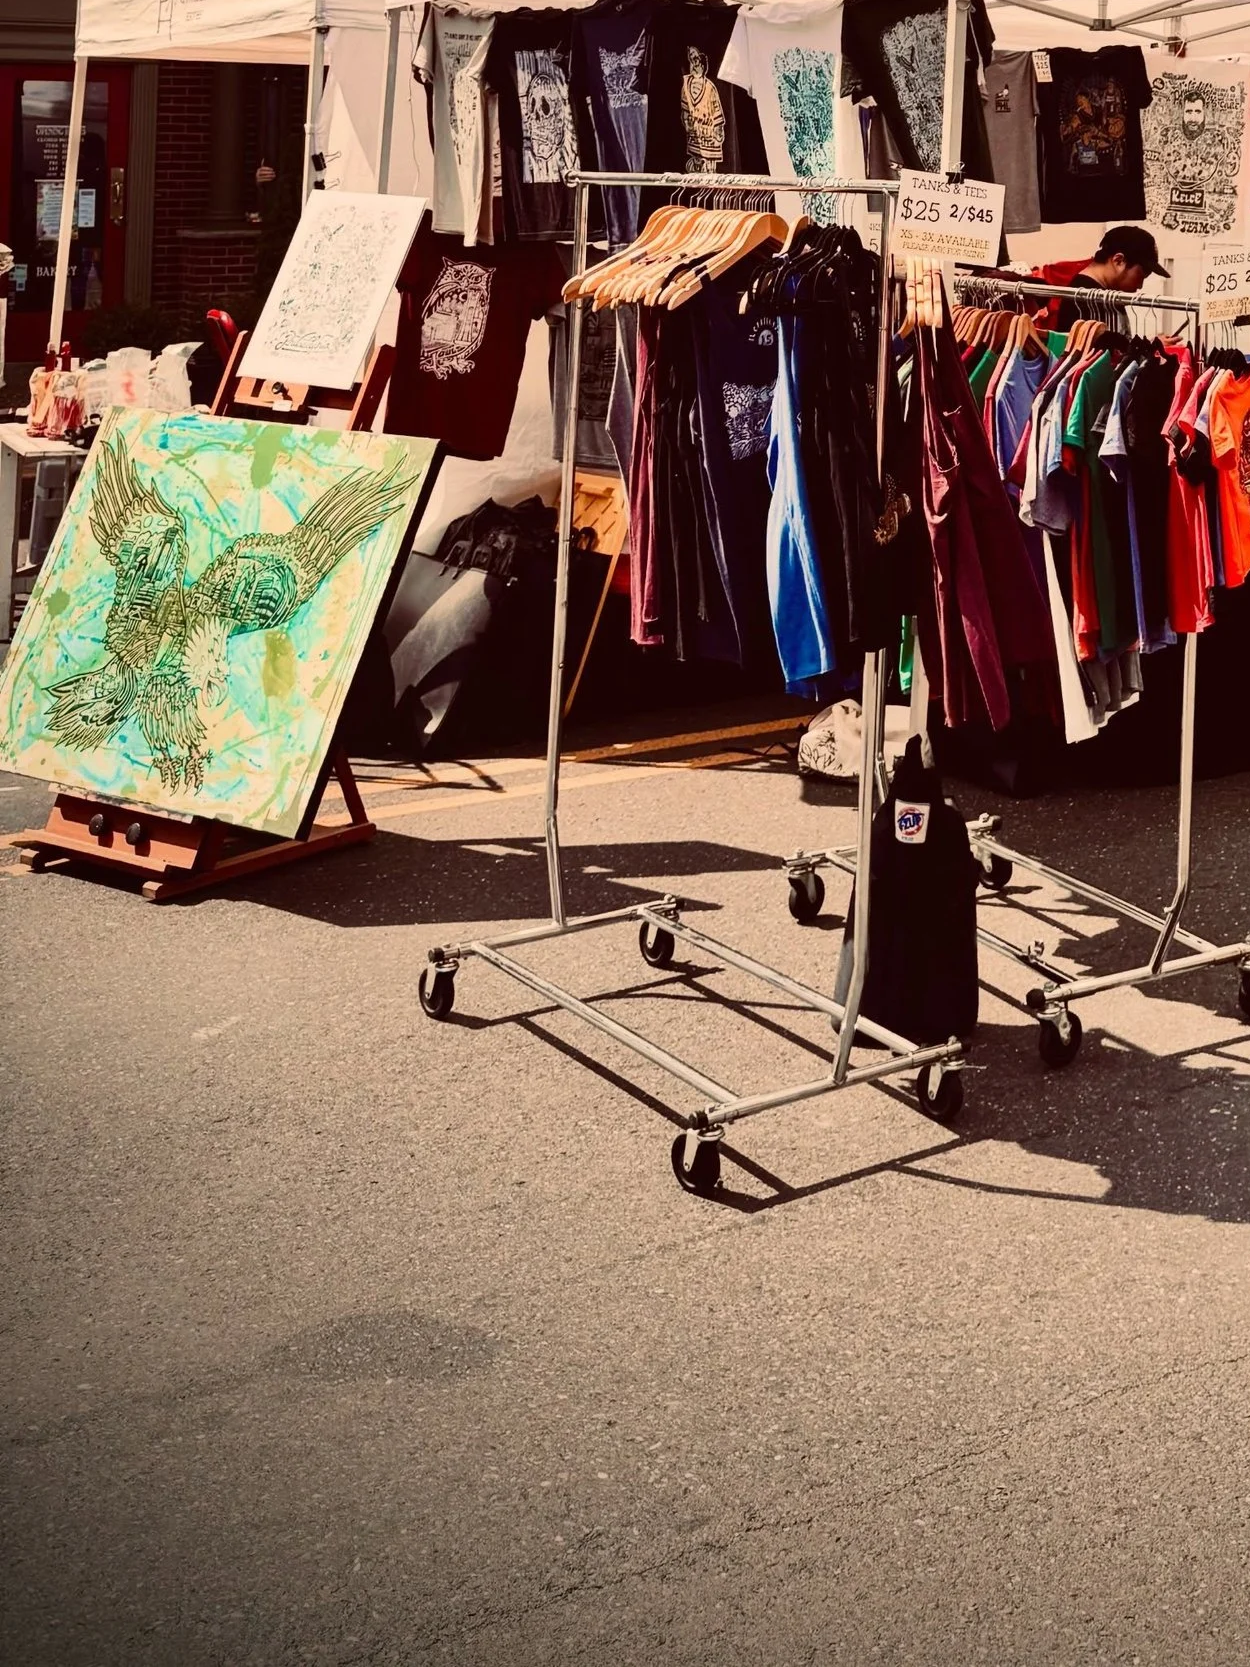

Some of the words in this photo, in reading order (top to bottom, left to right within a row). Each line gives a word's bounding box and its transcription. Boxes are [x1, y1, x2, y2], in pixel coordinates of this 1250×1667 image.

[1036, 62, 1049, 70] $25
[912, 177, 950, 194] TANKS
[953, 184, 961, 195] &
[965, 186, 987, 199] TEES
[901, 196, 940, 222] $25
[950, 204, 993, 223] 2/$45
[900, 229, 913, 239] XS
[922, 232, 934, 243] 3X
[937, 235, 990, 250] AVAILABLE
[1213, 253, 1245, 266] TANKS
[1206, 273, 1238, 294] $25
[1206, 301, 1217, 310] XS
